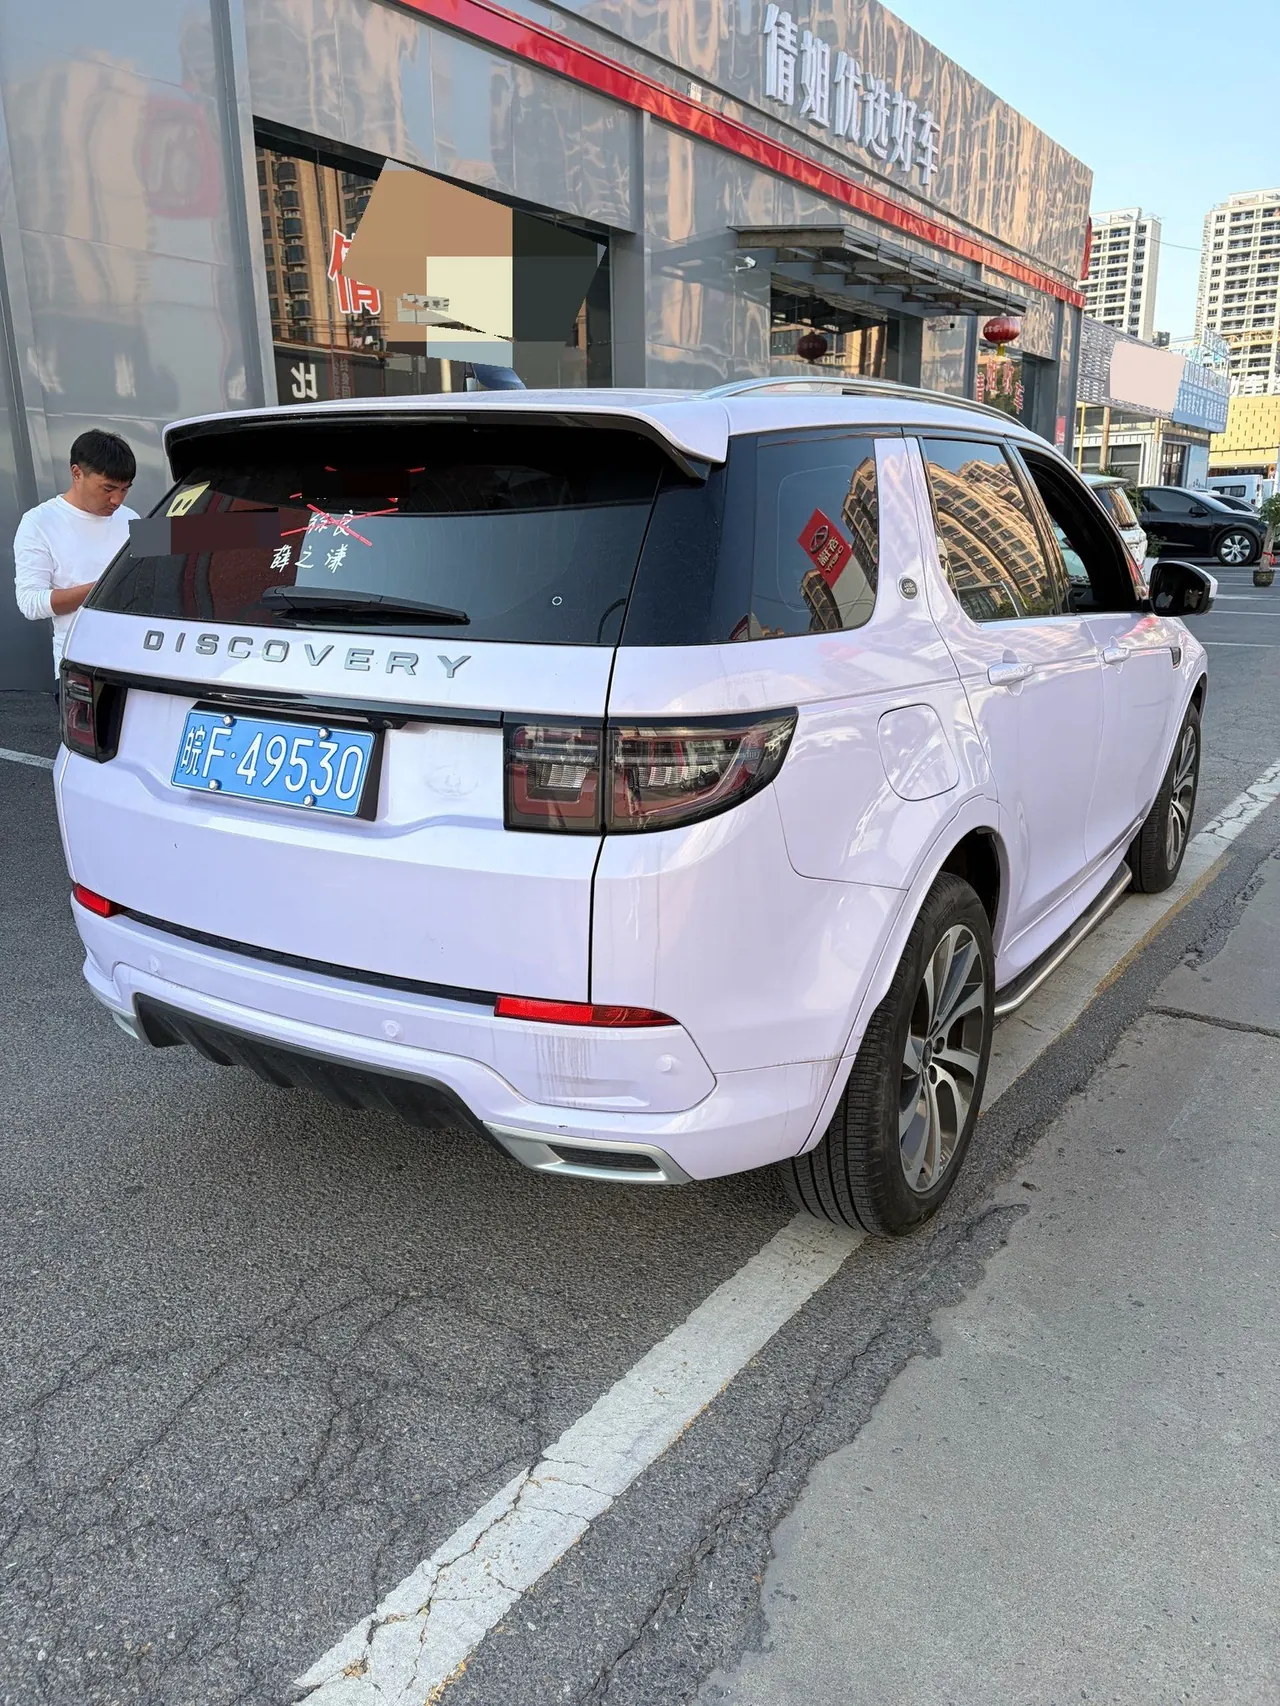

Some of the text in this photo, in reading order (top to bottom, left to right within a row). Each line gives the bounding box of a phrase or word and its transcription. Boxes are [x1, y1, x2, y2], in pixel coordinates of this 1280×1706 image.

[763, 3, 940, 186] 倩姐优选好车
[143, 629, 472, 679] DISCOVERY
